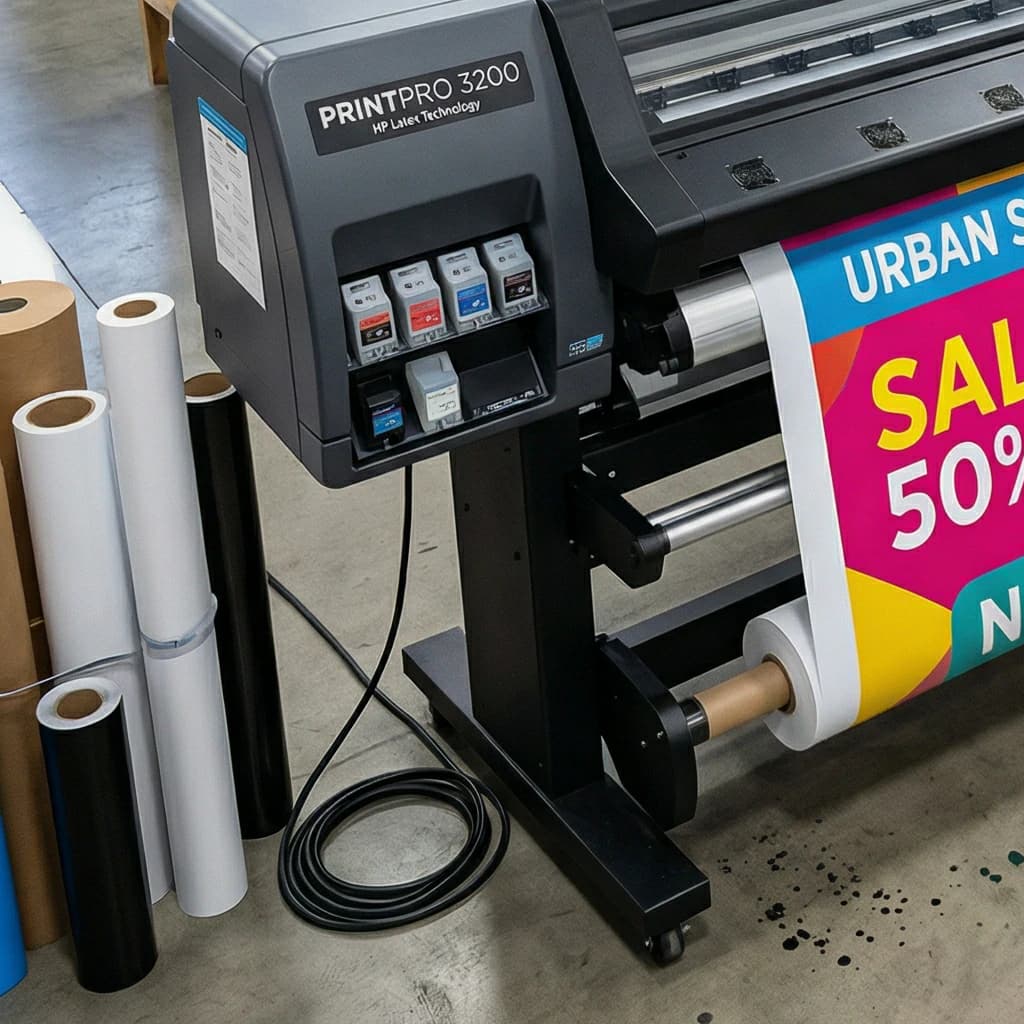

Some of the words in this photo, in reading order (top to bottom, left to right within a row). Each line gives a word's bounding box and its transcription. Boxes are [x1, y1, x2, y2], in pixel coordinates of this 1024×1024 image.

[319, 78, 452, 129] PRINTPRO
[457, 61, 520, 94] 3200
[372, 121, 388, 135] HP
[420, 100, 480, 123] Technology
[842, 209, 998, 303] URBAN
